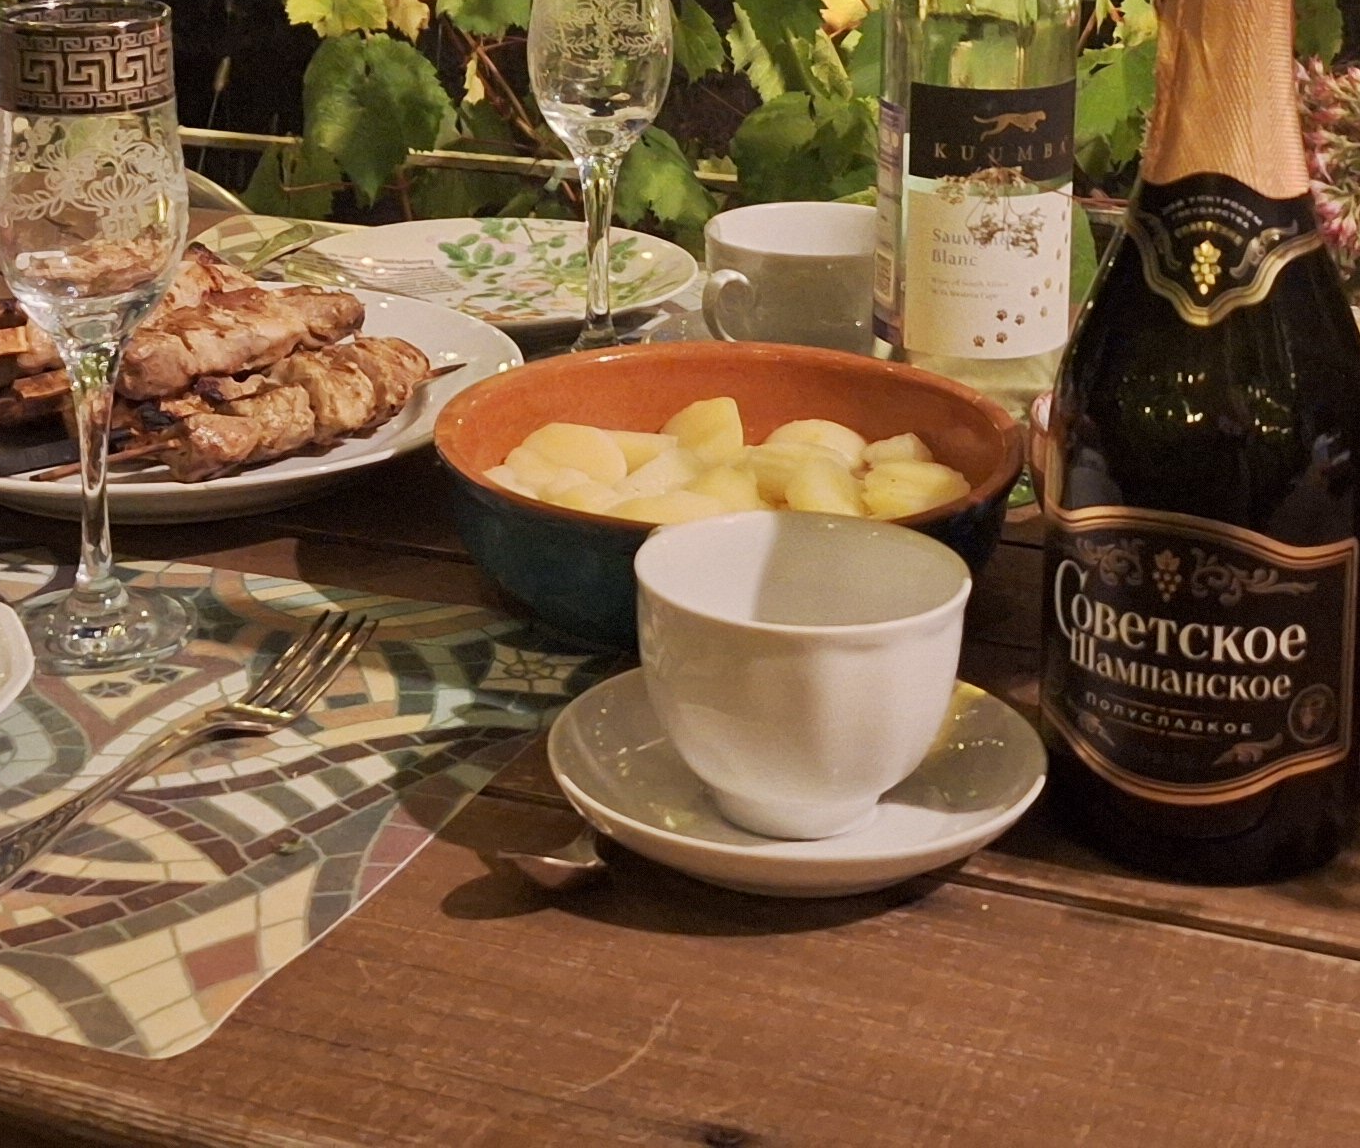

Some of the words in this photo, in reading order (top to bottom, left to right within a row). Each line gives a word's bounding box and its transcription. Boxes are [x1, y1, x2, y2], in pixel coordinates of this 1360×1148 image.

[931, 248, 979, 267] Blanc
[1054, 558, 1308, 664] Советское
[1070, 626, 1292, 701] Шампанское
[1085, 691, 1253, 736] ПОЛУСЛАДКОЕ
